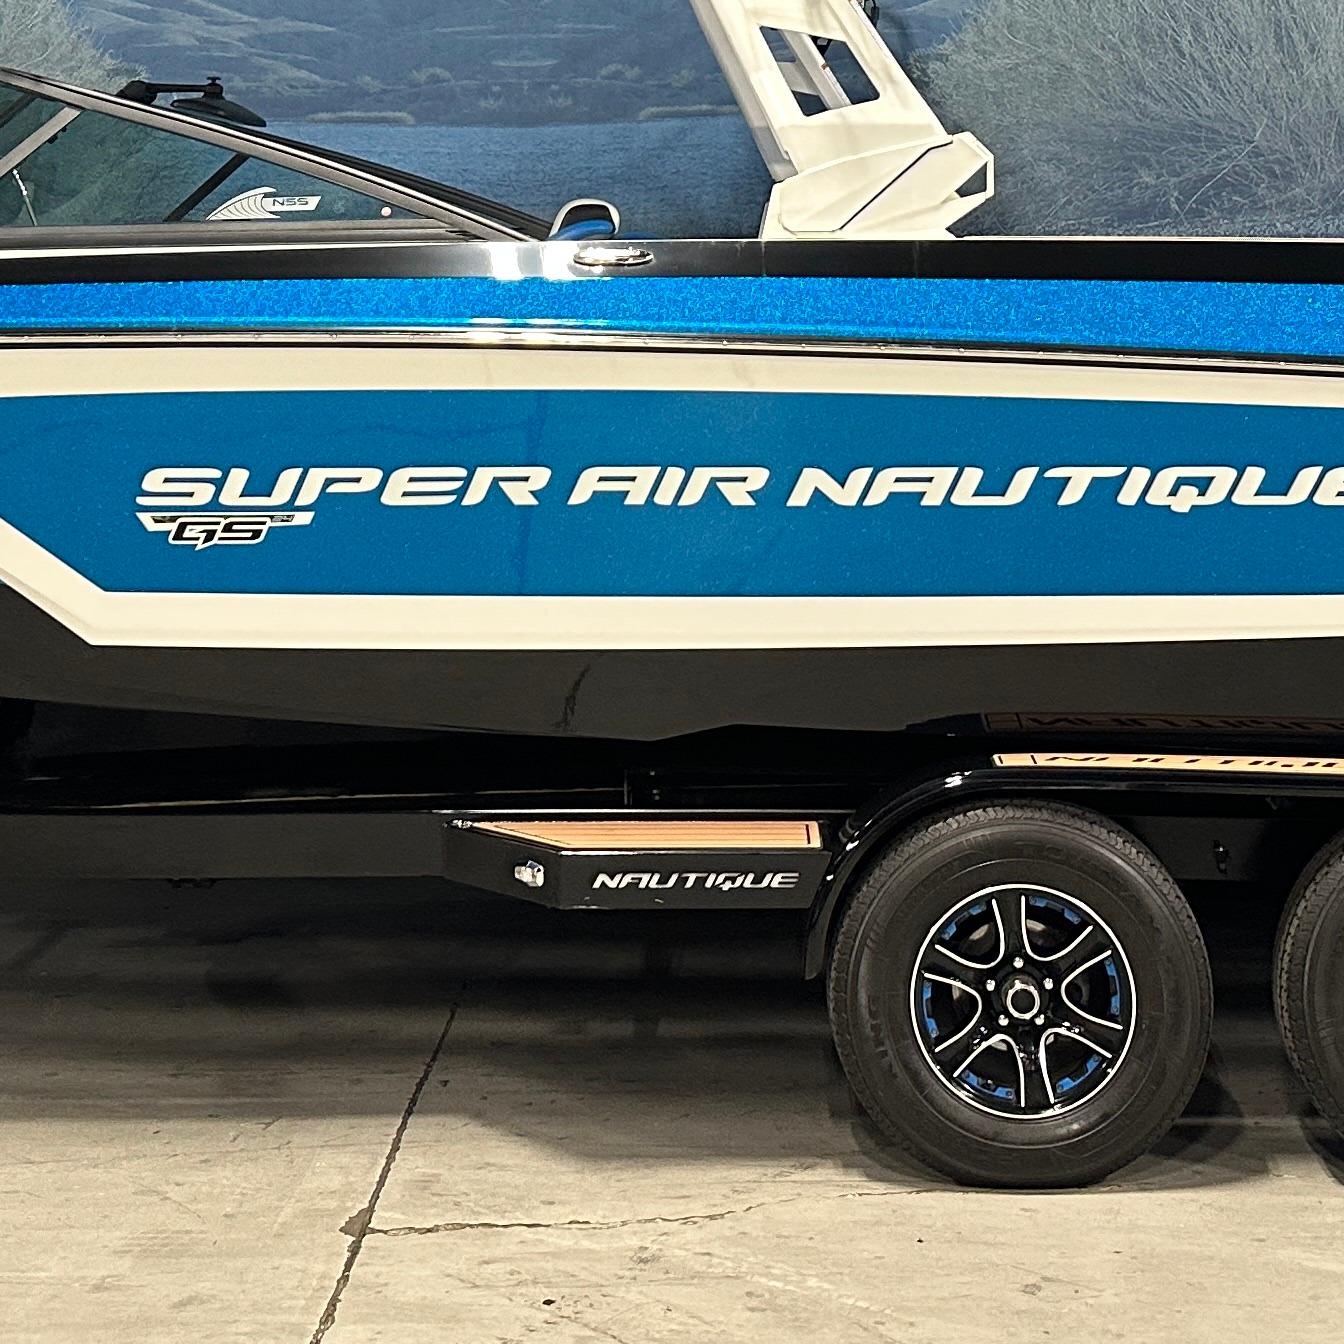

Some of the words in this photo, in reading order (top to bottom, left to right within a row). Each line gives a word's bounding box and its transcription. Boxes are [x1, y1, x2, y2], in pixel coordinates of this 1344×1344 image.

[272, 196, 309, 207] NSS
[135, 465, 553, 506] SUPER
[566, 465, 771, 506] AIR
[591, 872, 800, 891] NAUTIQUE
